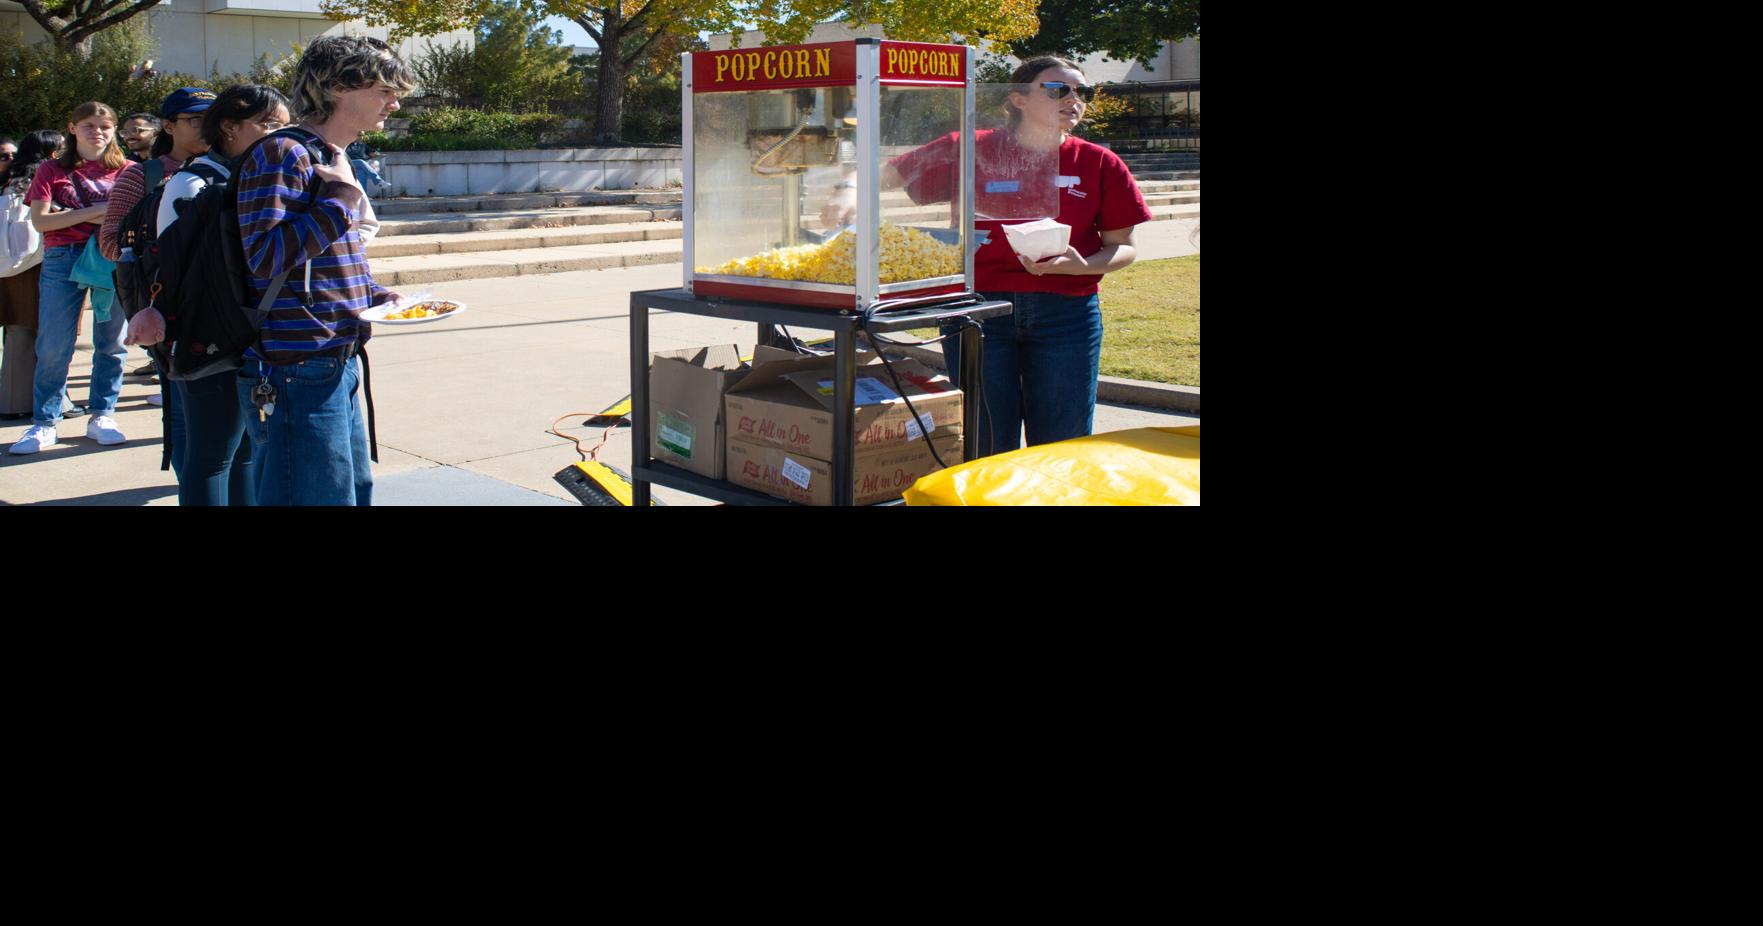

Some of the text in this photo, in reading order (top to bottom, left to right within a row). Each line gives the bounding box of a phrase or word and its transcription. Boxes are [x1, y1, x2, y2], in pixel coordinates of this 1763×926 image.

[715, 48, 831, 82] POPCORN
[887, 48, 960, 76] POPCORN
[759, 418, 776, 438] All
[790, 424, 811, 444] One
[865, 424, 881, 444] All
[862, 474, 878, 493] All
[894, 469, 913, 487] One
